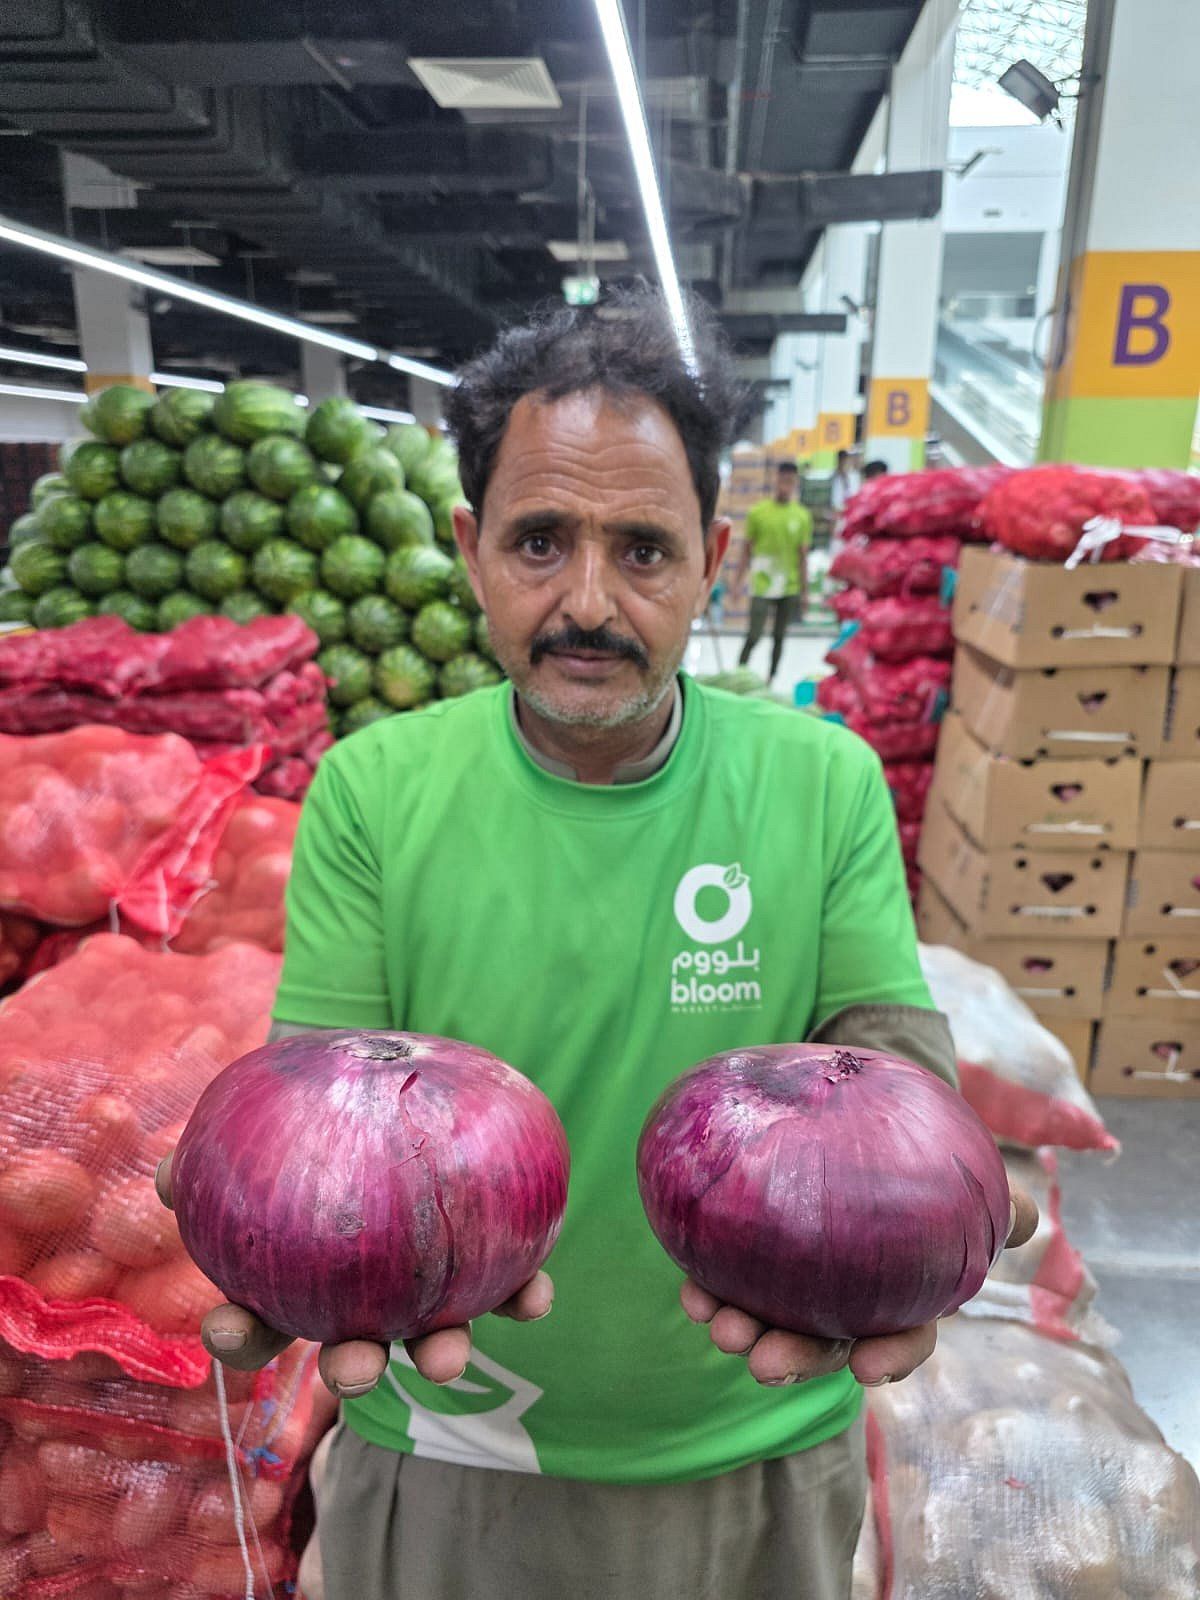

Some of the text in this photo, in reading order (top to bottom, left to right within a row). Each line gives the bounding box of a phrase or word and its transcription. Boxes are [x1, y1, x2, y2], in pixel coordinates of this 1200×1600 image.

[1112, 284, 1170, 366] B
[886, 391, 910, 426] B
[671, 977, 761, 1003] bloom
